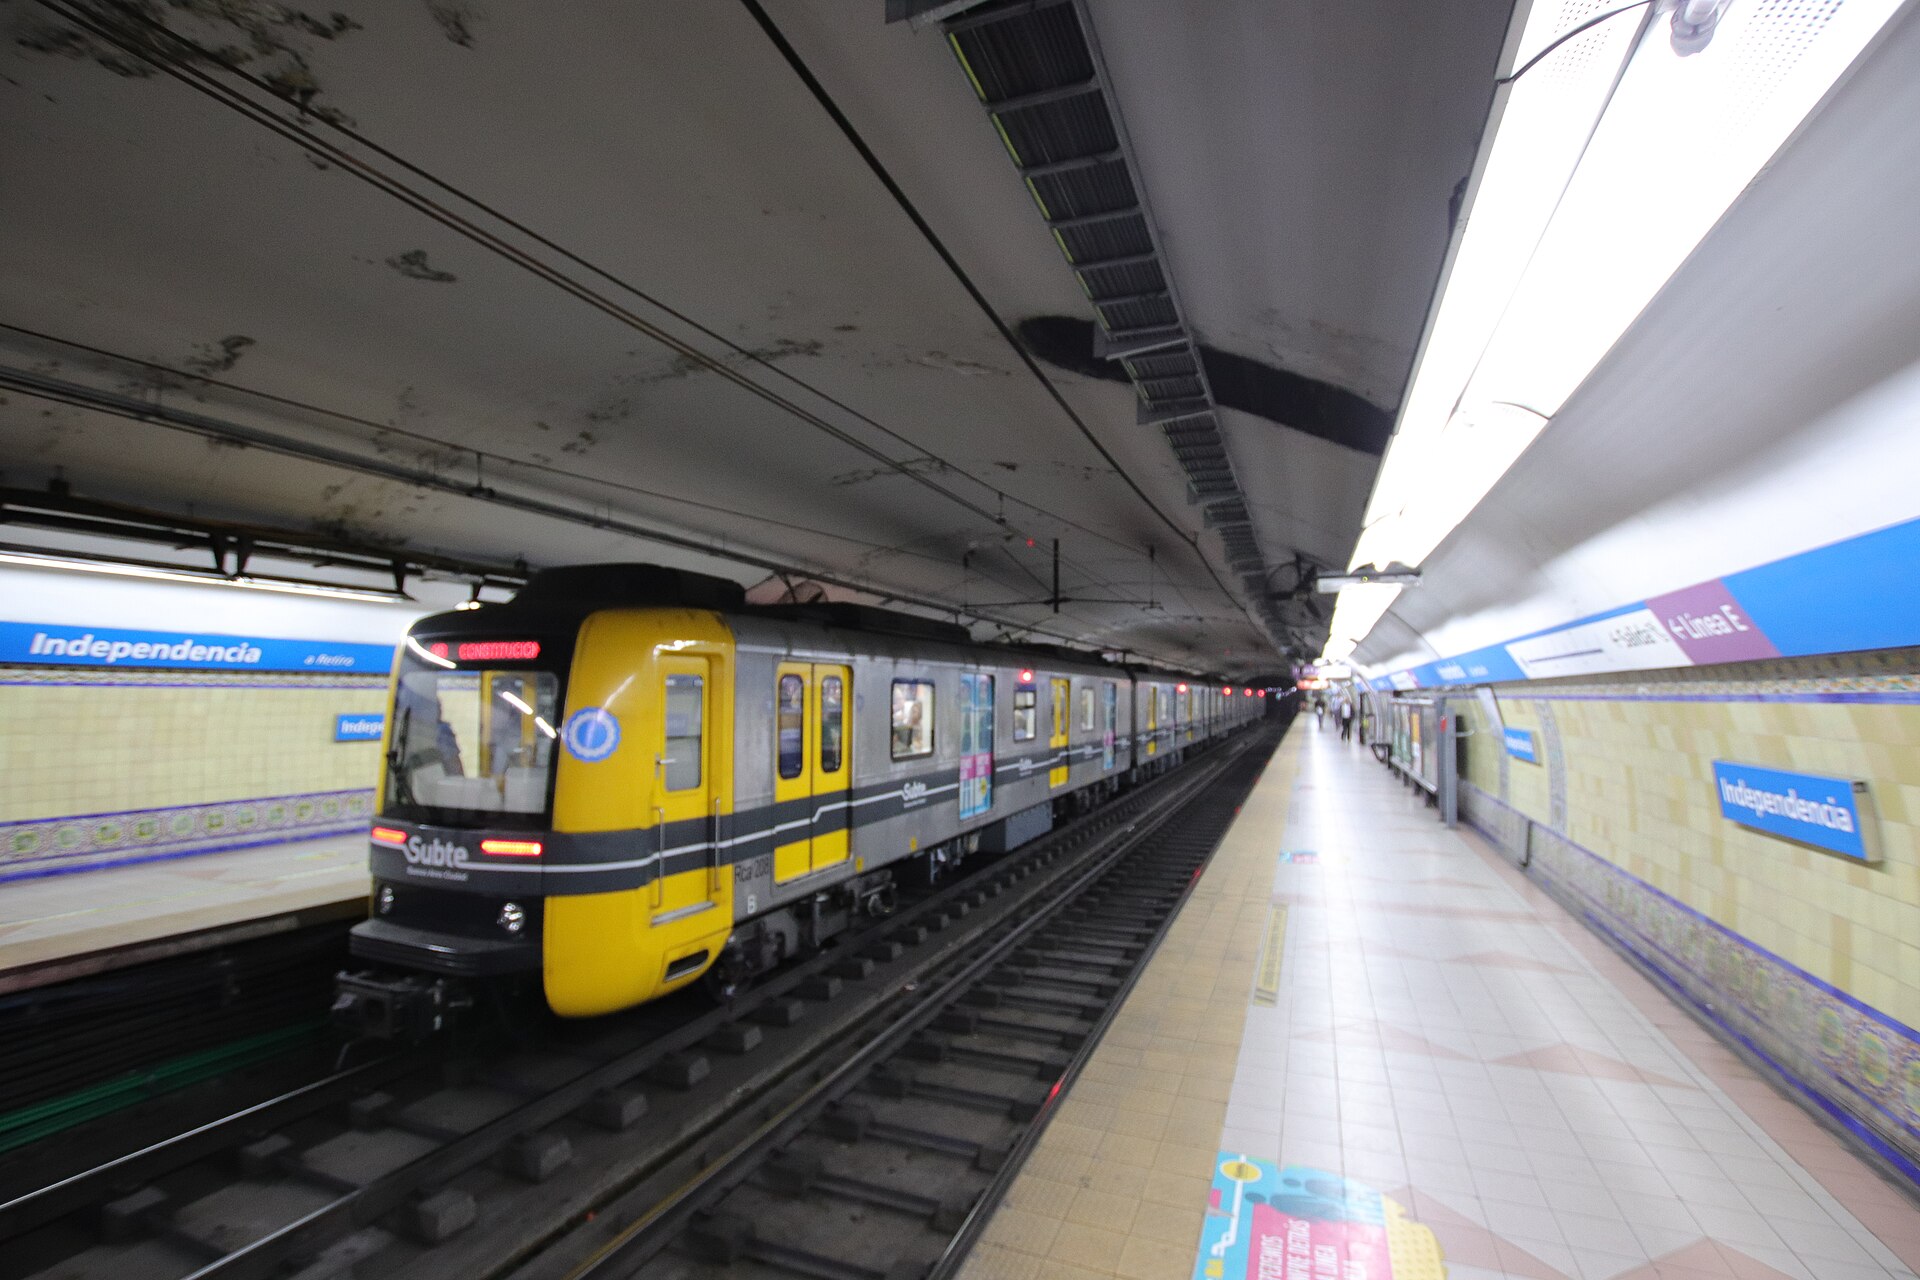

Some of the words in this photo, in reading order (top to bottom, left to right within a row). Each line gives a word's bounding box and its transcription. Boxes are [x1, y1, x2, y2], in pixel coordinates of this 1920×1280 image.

[1677, 612, 1734, 639] Línea
[1719, 604, 1750, 632] E
[29, 632, 262, 664] Independencia
[1719, 776, 1855, 833] Independencia
[407, 835, 469, 868] Subte
